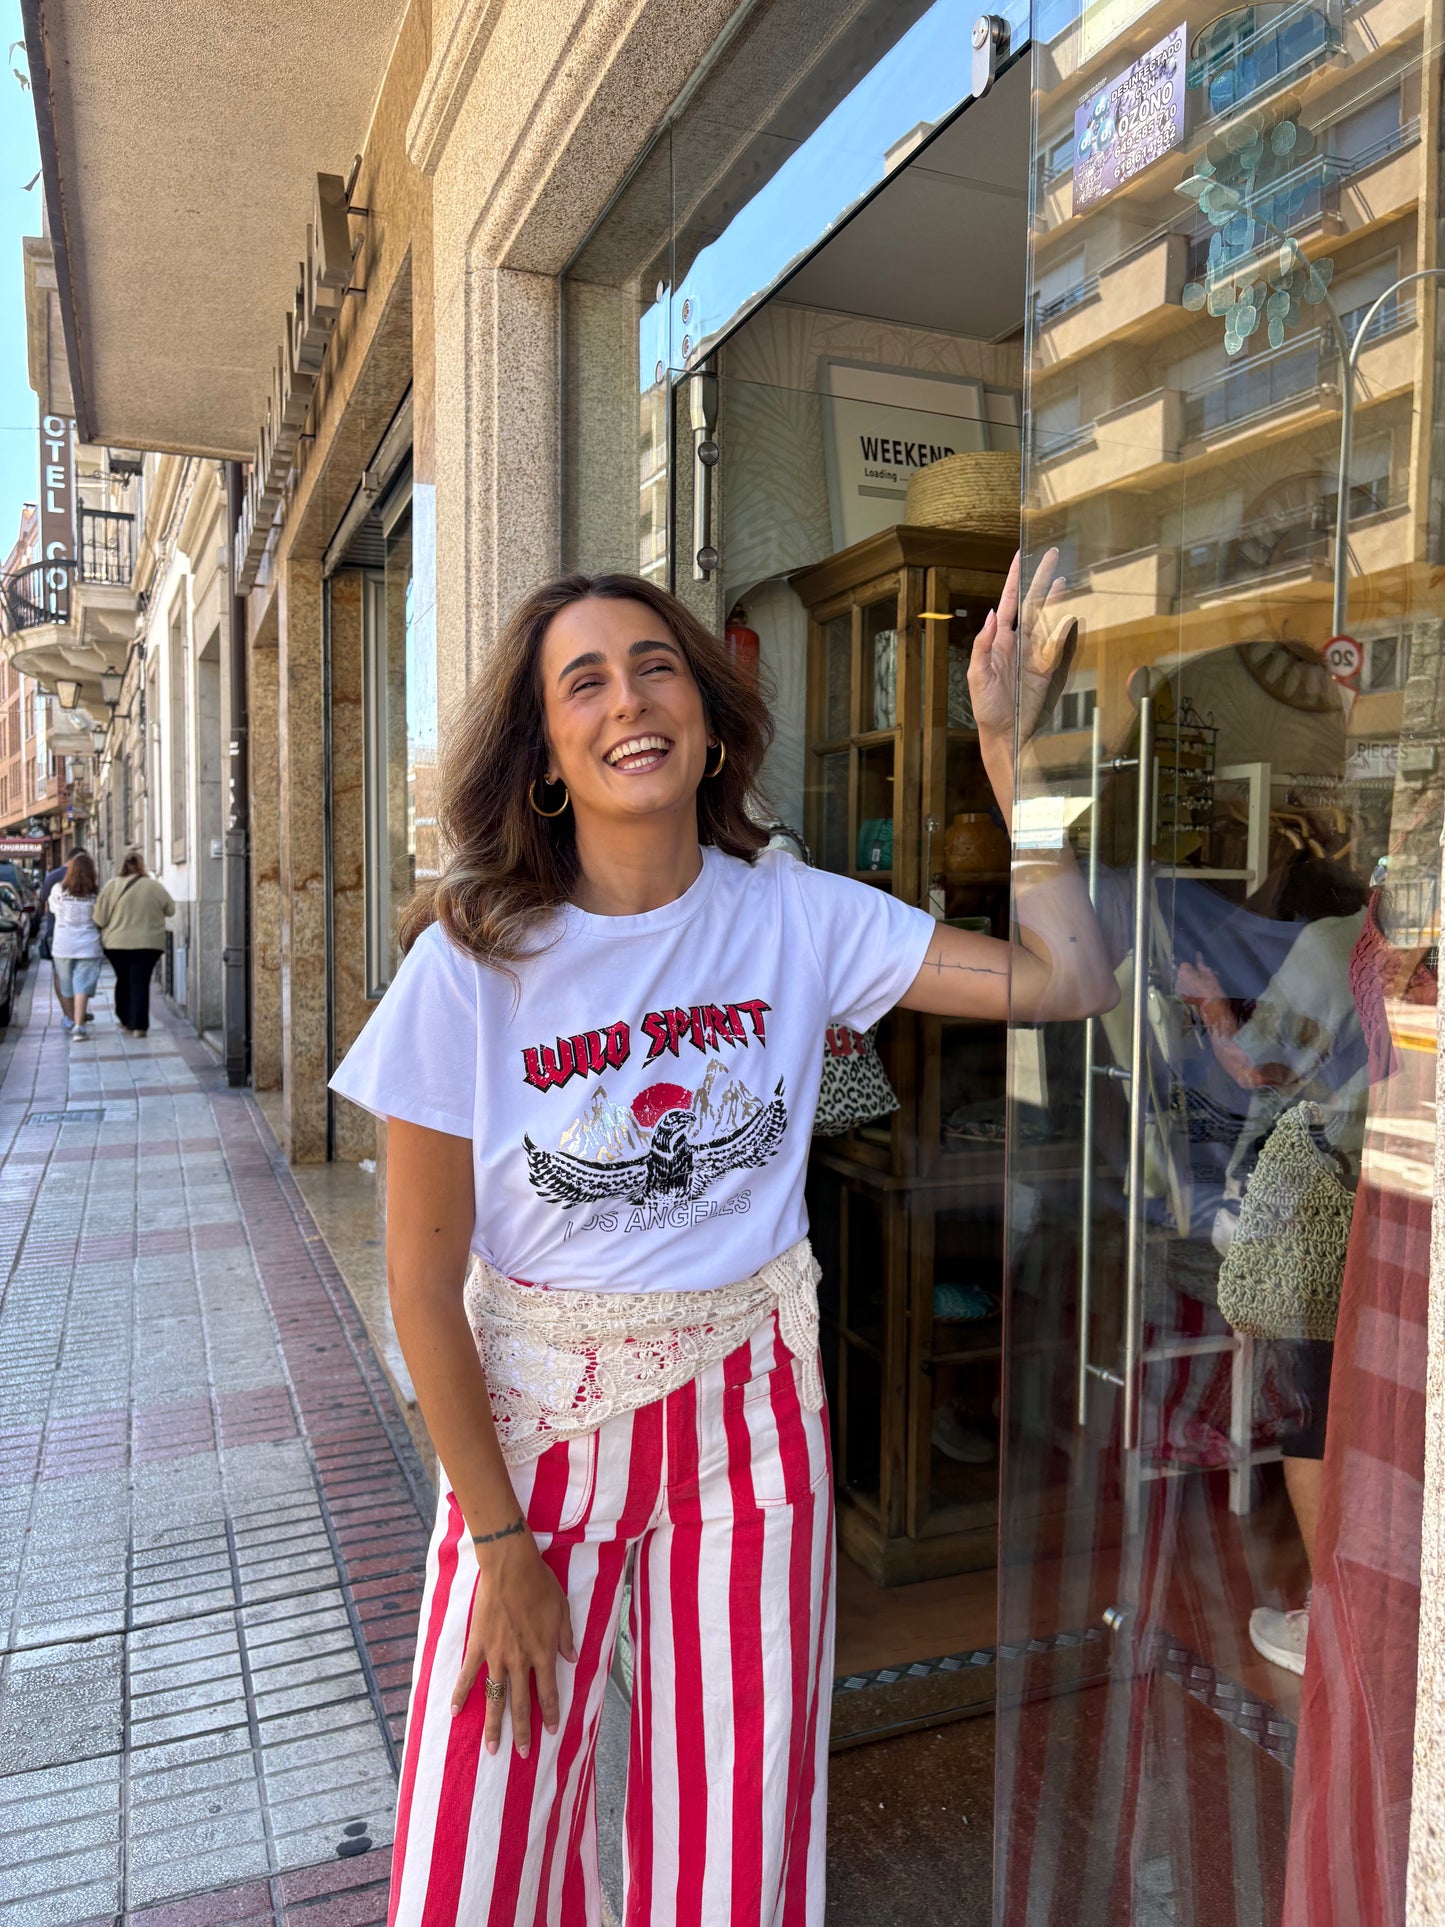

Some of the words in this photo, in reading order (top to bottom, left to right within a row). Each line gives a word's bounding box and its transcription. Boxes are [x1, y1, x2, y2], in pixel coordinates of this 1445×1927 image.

[1111, 38, 1183, 103] DESINFECTADO
[1135, 76, 1156, 100] CON
[1117, 80, 1174, 138] OZONO
[1114, 136, 1134, 159] 649
[1135, 120, 1155, 143] 585
[1114, 156, 1133, 179] 618
[1135, 140, 1155, 164] 614
[1156, 123, 1177, 149] 932
[864, 467, 897, 482] Loading
[1357, 742, 1409, 760] PIECES
[520, 1020, 631, 1094] WILD
[640, 998, 772, 1070] SPIRIT
